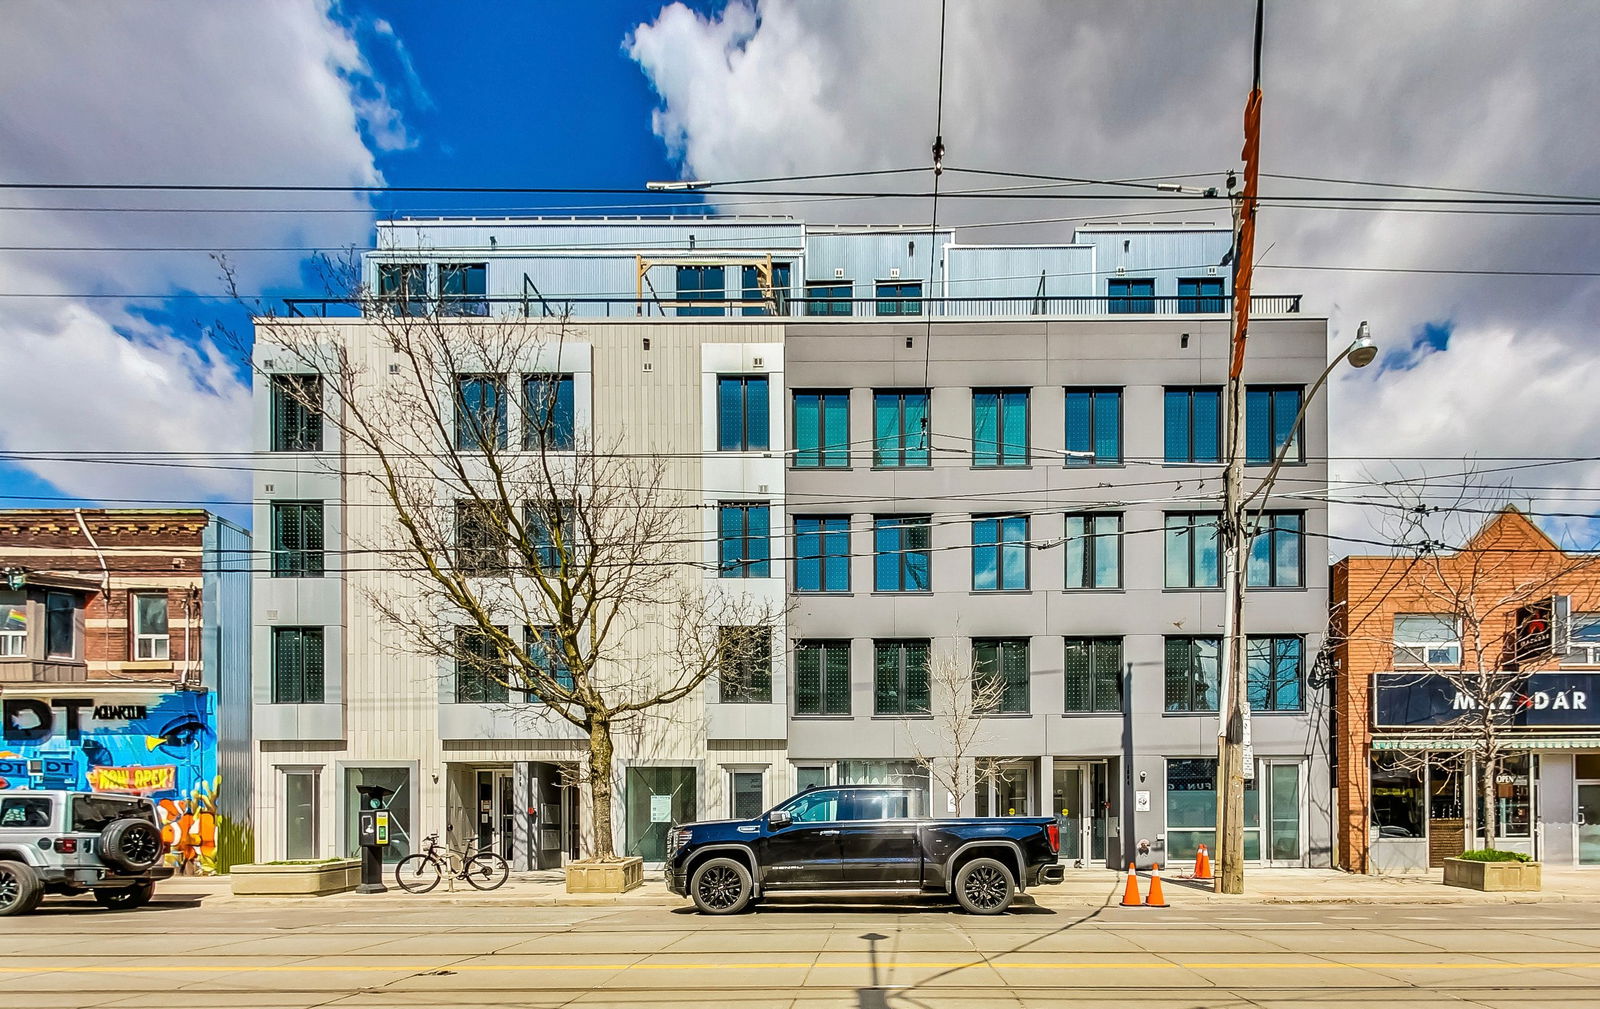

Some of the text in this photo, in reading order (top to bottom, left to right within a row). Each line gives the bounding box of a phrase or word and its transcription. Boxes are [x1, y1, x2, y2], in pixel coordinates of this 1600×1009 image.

[92, 705, 147, 720] AQUARIUM
[3, 698, 94, 742] DT
[46, 762, 73, 773] DT
[1496, 775, 1515, 783] OPEN
